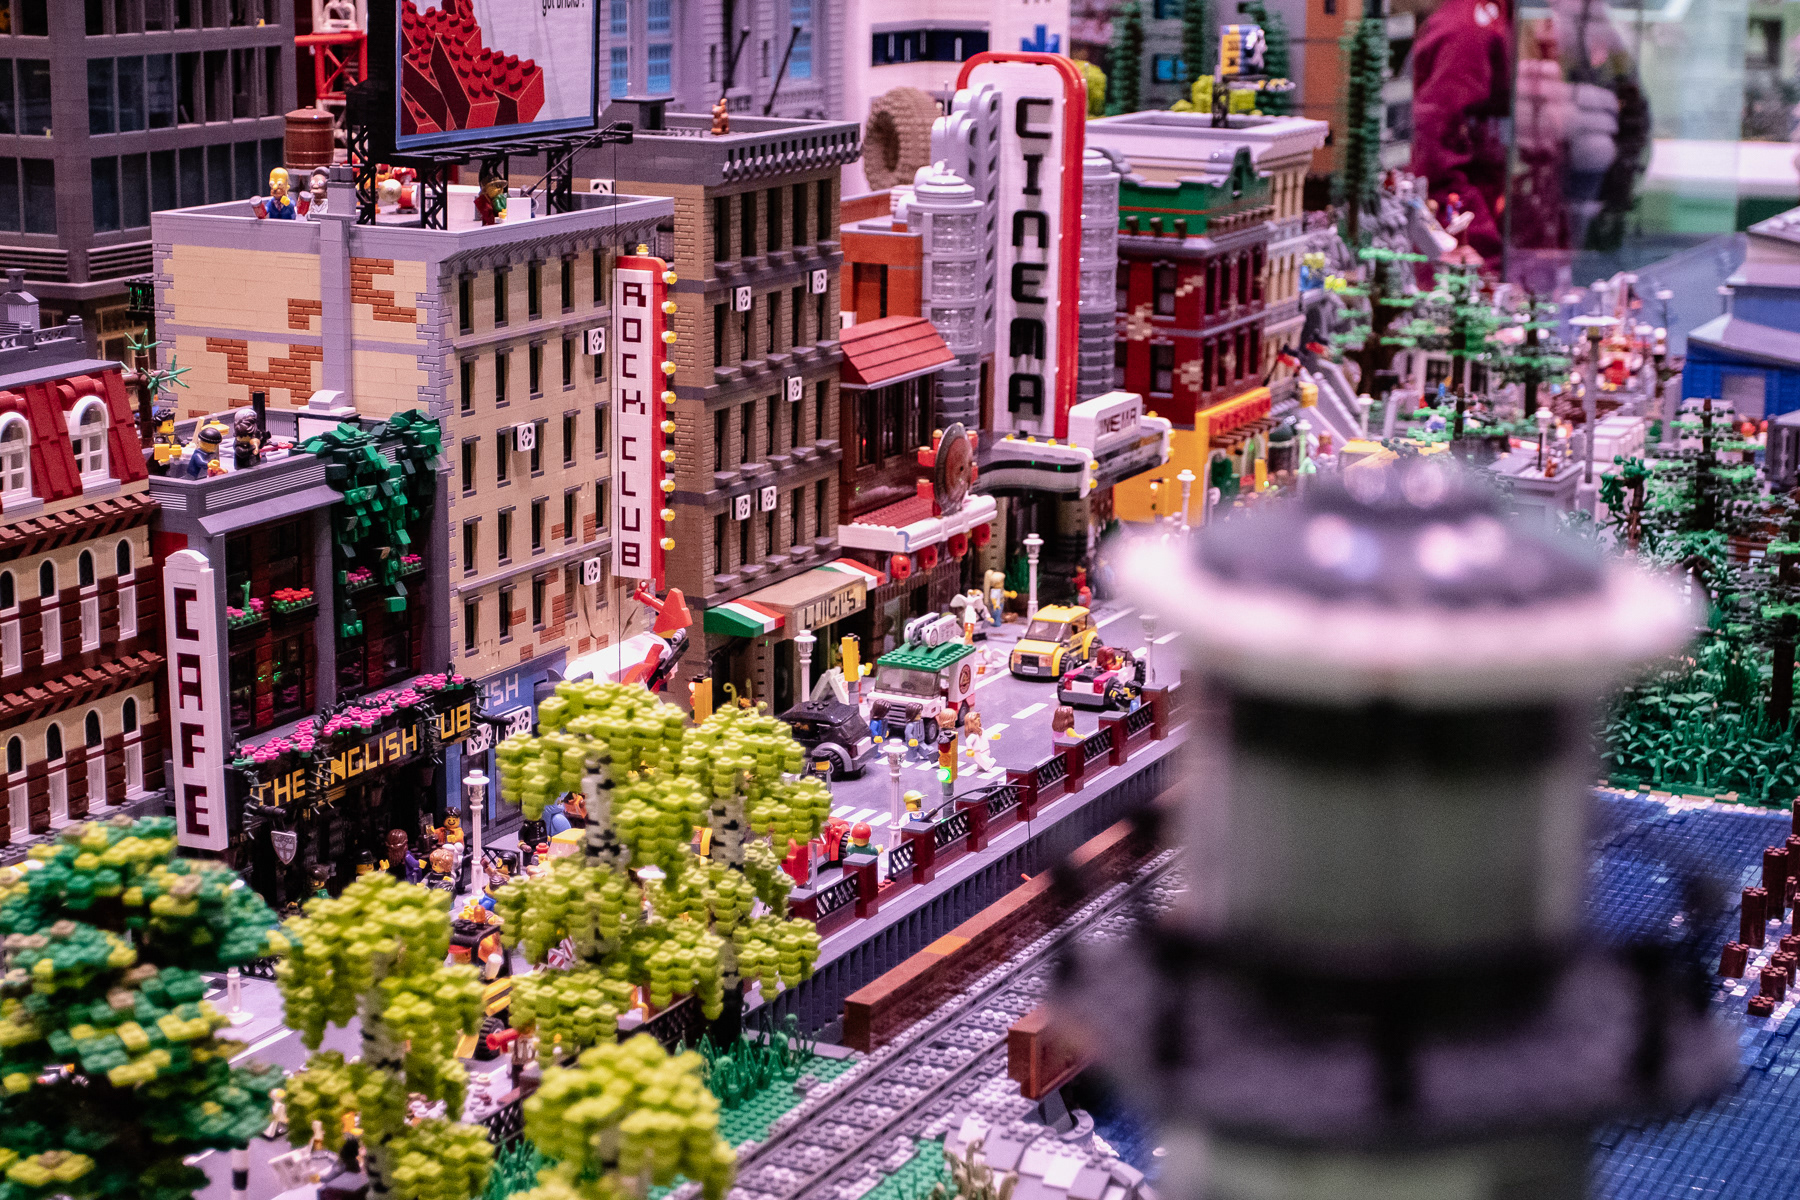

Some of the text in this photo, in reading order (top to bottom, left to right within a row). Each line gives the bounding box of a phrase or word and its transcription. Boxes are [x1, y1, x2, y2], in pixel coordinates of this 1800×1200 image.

[1008, 97, 1053, 416] CINEMA
[622, 281, 647, 567] ROCK CLUB
[174, 586, 210, 837] CAFE
[250, 768, 306, 807] THE
[430, 702, 471, 740] UB
[485, 672, 519, 710] ISH
